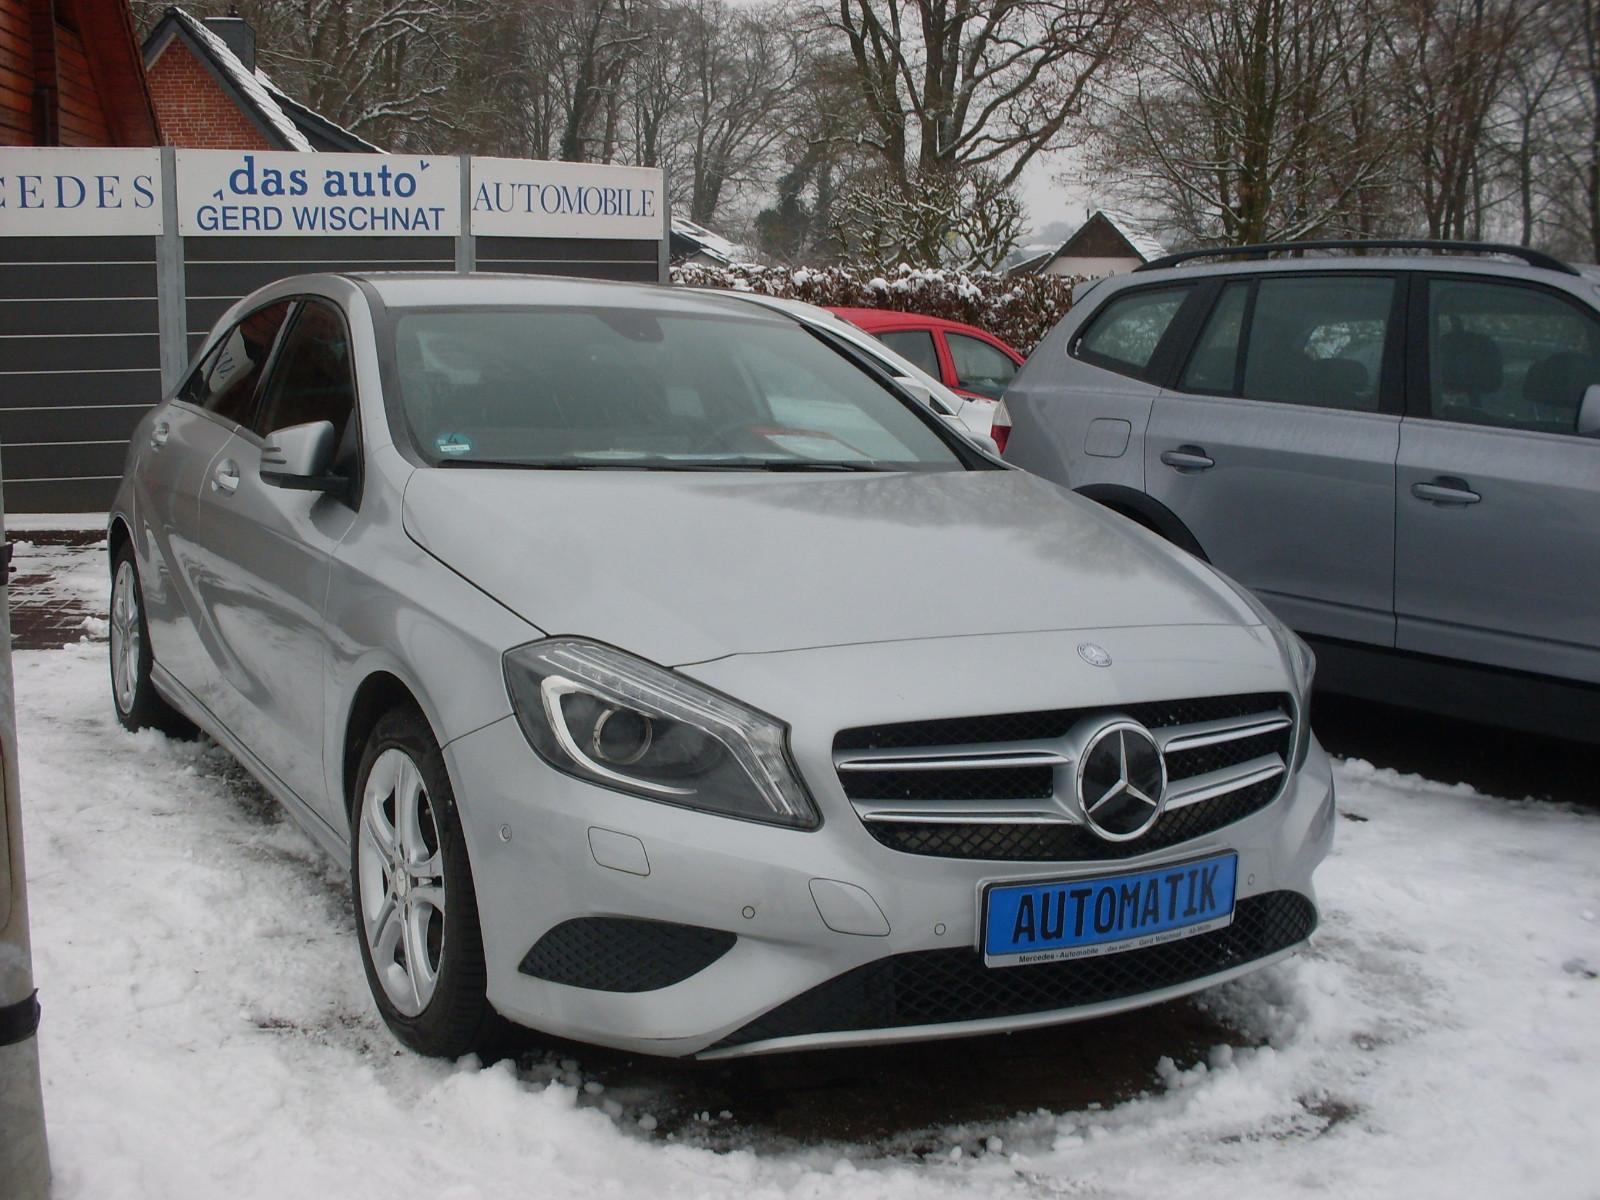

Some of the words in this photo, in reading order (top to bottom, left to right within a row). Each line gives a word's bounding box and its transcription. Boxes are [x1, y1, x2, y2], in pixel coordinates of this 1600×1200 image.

[0, 175, 155, 208] EDES
[229, 156, 308, 196] das
[324, 165, 417, 198] auto
[472, 181, 656, 217] AUTOMOBILE
[197, 206, 283, 231] GERD
[292, 206, 445, 231] WISCHNAT
[1012, 864, 1219, 944] AUTOMATIK
